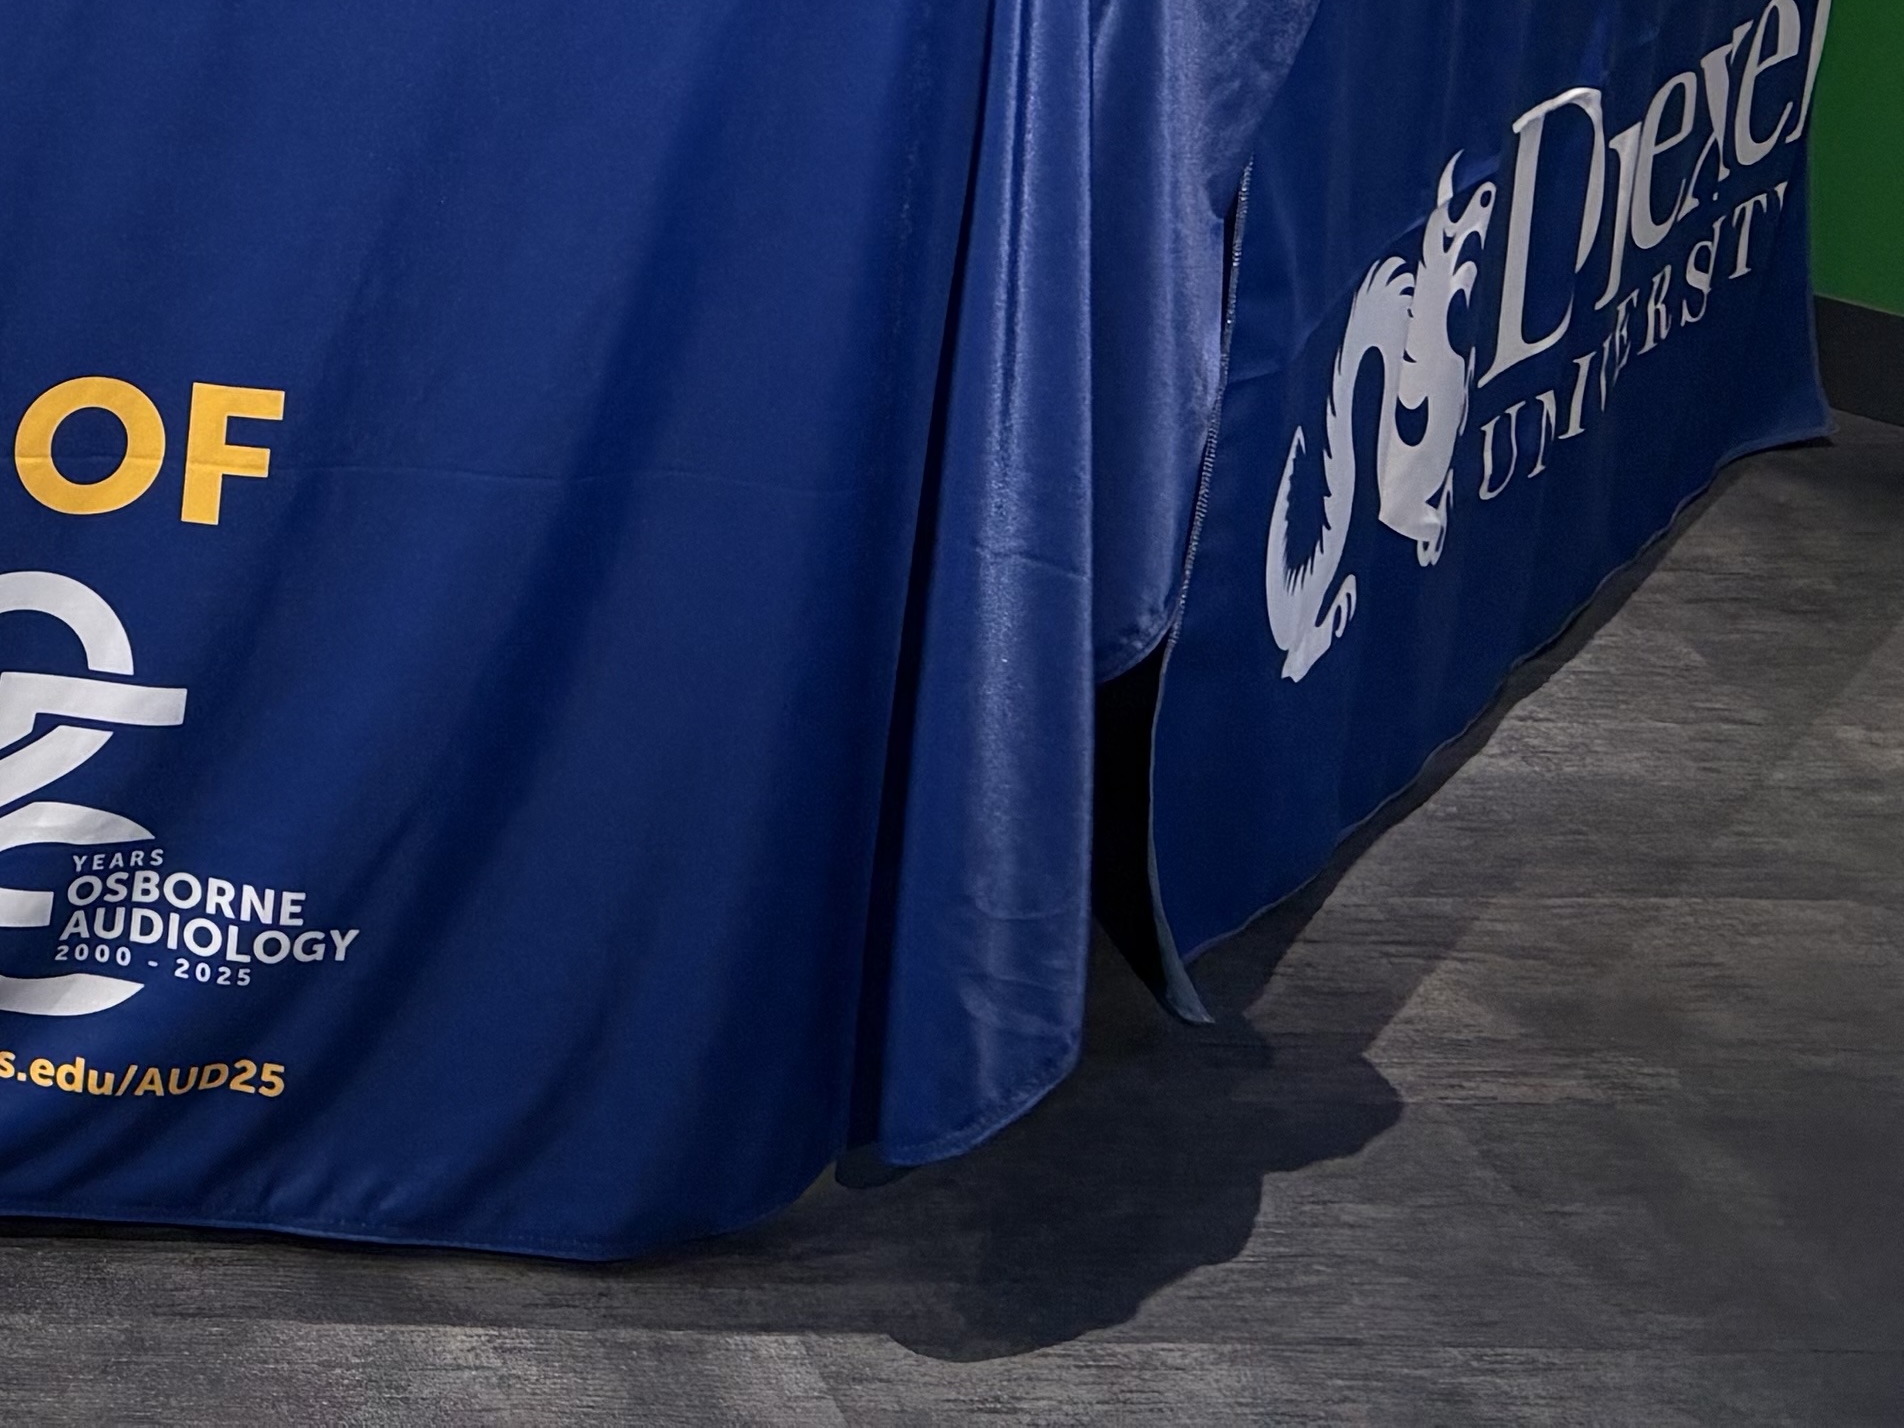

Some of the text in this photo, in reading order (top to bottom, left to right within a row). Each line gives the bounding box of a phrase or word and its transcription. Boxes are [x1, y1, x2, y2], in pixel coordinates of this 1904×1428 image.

[14, 375, 285, 525] OF
[72, 848, 164, 872] YEARS
[67, 872, 306, 926] OSBORNE
[59, 908, 360, 963] AUDIOLOGY
[54, 944, 251, 987] 2000 2025
